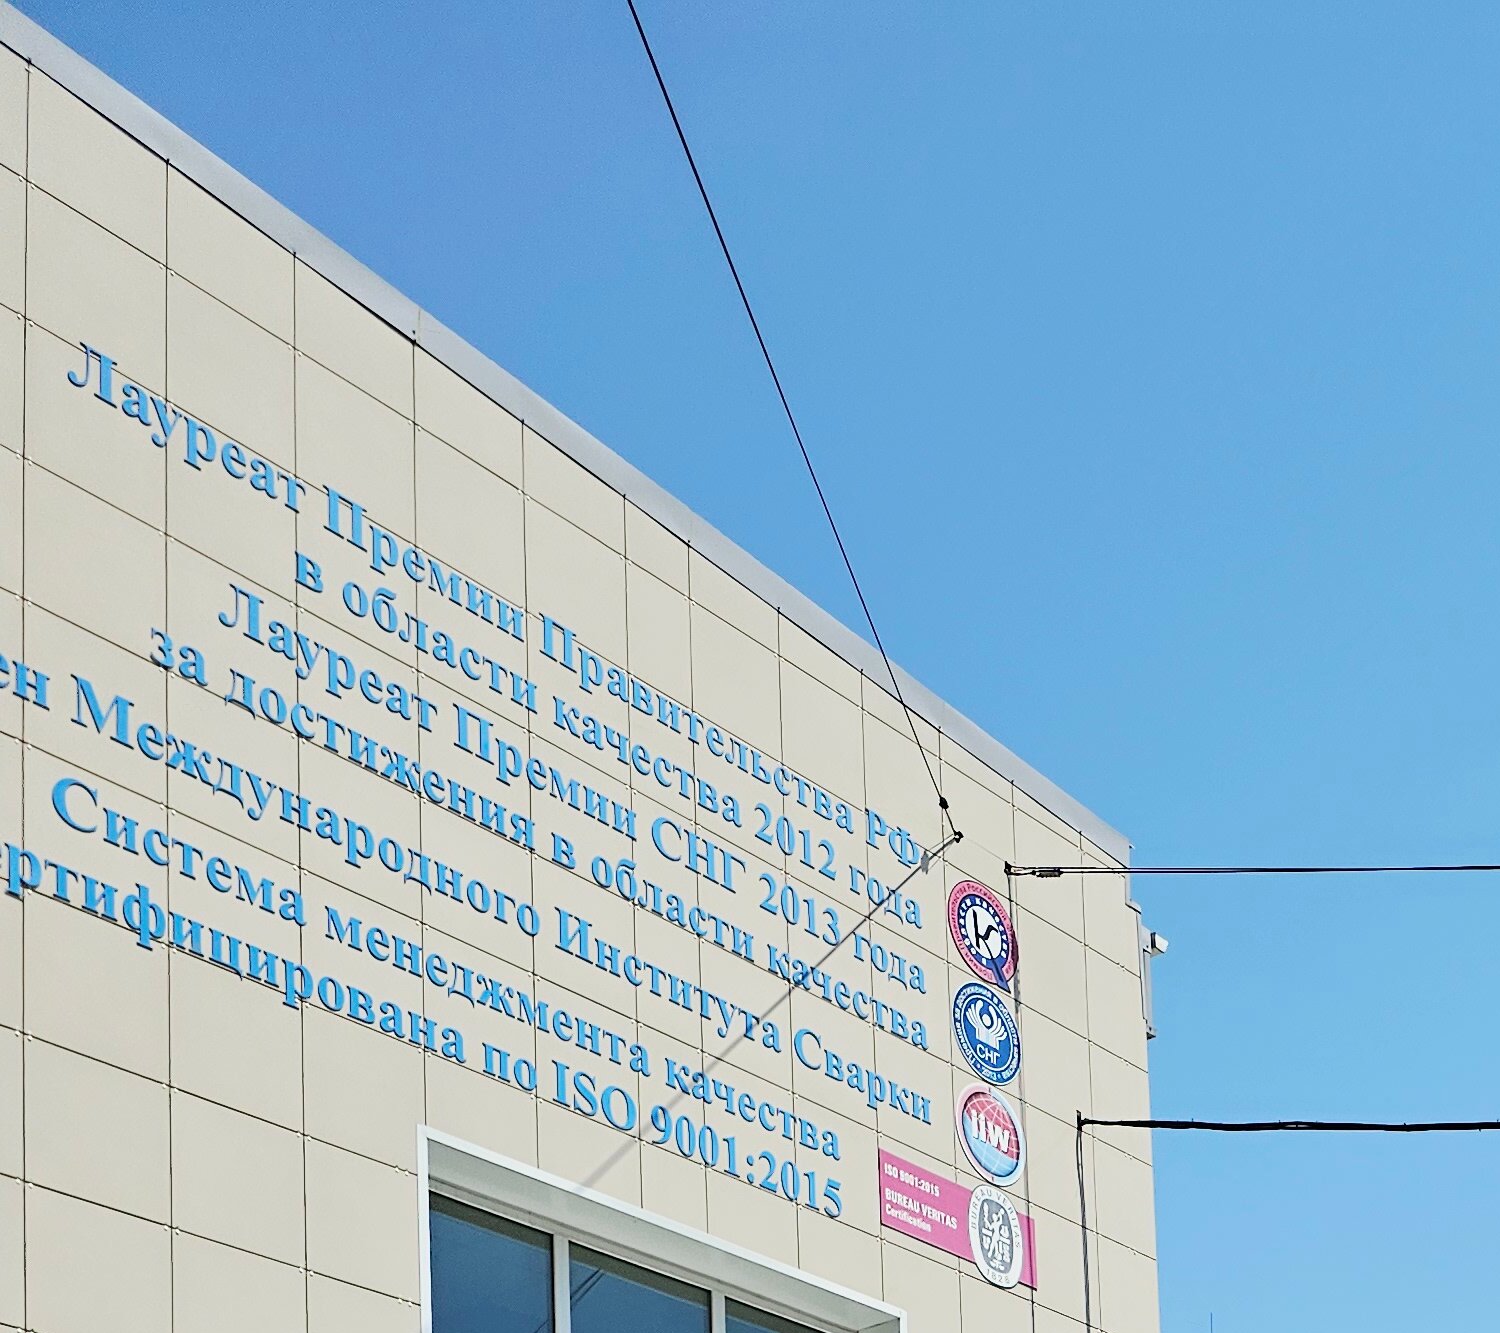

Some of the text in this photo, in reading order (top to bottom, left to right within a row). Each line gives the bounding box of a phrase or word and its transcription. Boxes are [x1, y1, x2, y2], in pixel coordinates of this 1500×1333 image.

[67, 342, 920, 869] Лауреат Премии Правительства РФ
[218, 584, 437, 731] Лауреат
[453, 703, 637, 840] Премии
[652, 815, 746, 893] СНГ
[759, 872, 841, 946] 2013
[853, 931, 926, 993] года
[294, 551, 922, 929] в области качества 2012 года
[51, 777, 841, 1161] Система менеджмента качества
[70, 674, 541, 936] Международного
[555, 907, 781, 1053] Института
[793, 1029, 932, 1125] Сварки
[150, 628, 208, 687] за
[225, 668, 535, 851] достижения
[551, 832, 577, 869] в
[591, 856, 755, 962] области
[767, 943, 929, 1050] качества
[0, 842, 843, 1218] ртифицирована по ISO 9001:2015
[884, 1162, 898, 1179] ISO
[885, 1187, 958, 1230] BUREAU VERITAS
[976, 1043, 1001, 1065] СНГ
